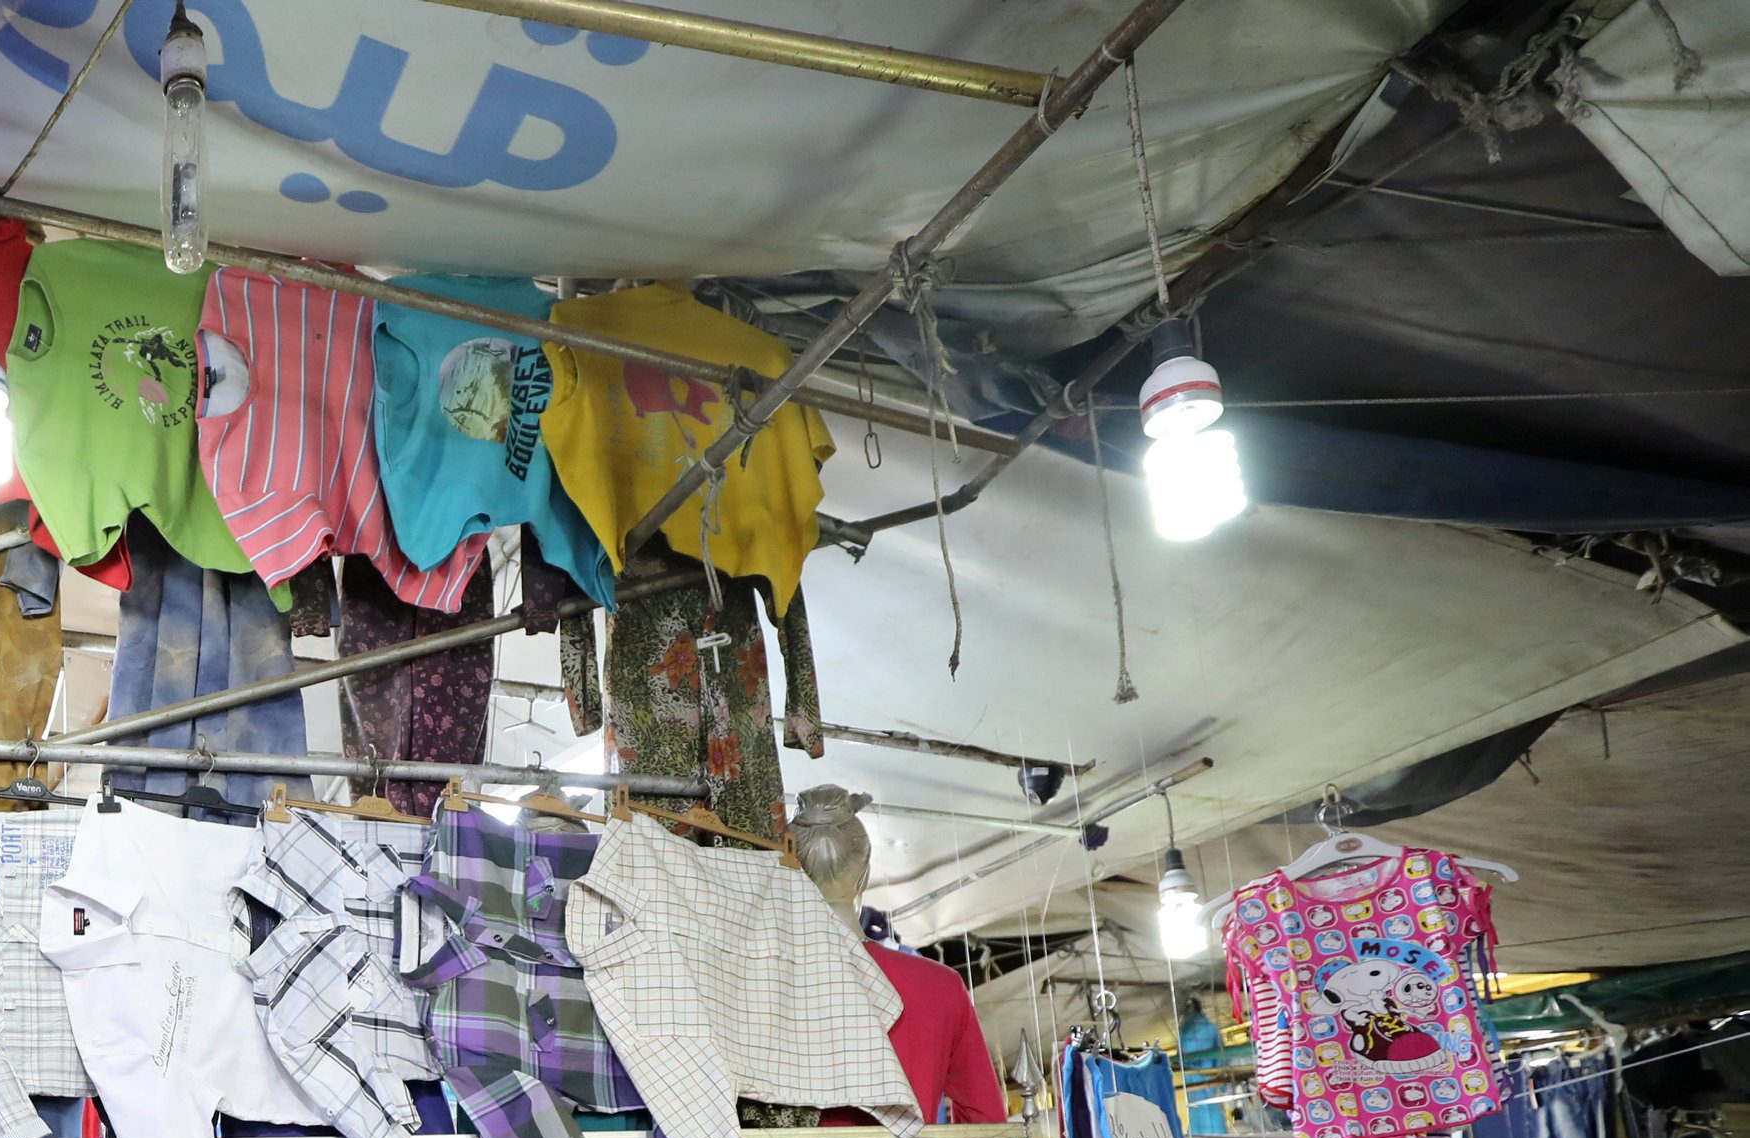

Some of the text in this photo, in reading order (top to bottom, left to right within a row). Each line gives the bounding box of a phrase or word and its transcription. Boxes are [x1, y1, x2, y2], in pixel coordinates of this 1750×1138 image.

[89, 315, 150, 410] HIMALAYA TRAIL
[508, 349, 555, 482] BOULEVAR
[16, 781, 42, 793] Yaren
[0, 823, 22, 864] PORT
[1359, 941, 1446, 980] MOSE!
